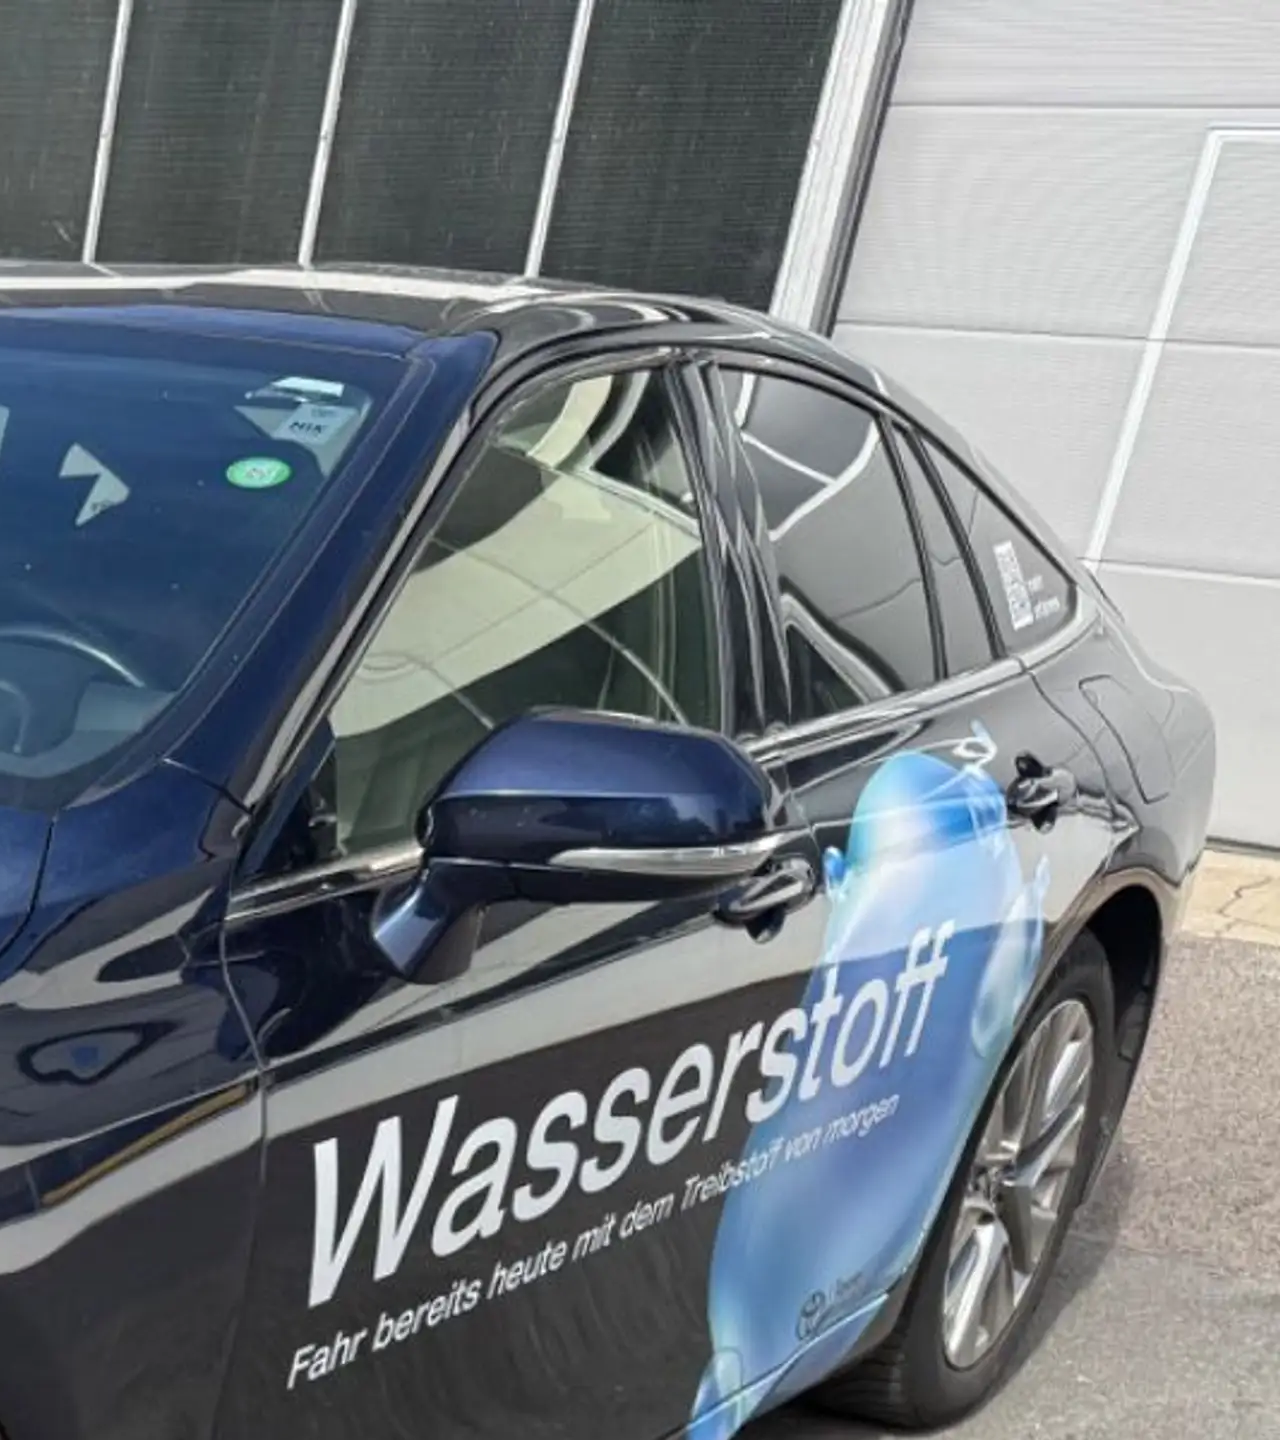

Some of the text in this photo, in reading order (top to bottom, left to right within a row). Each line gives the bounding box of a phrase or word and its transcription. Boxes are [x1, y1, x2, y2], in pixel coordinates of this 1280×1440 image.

[287, 1095, 901, 1390] Fahr bereits heute mit dem Treibstoff von morgen
[307, 920, 956, 1308] Wasserstoff
